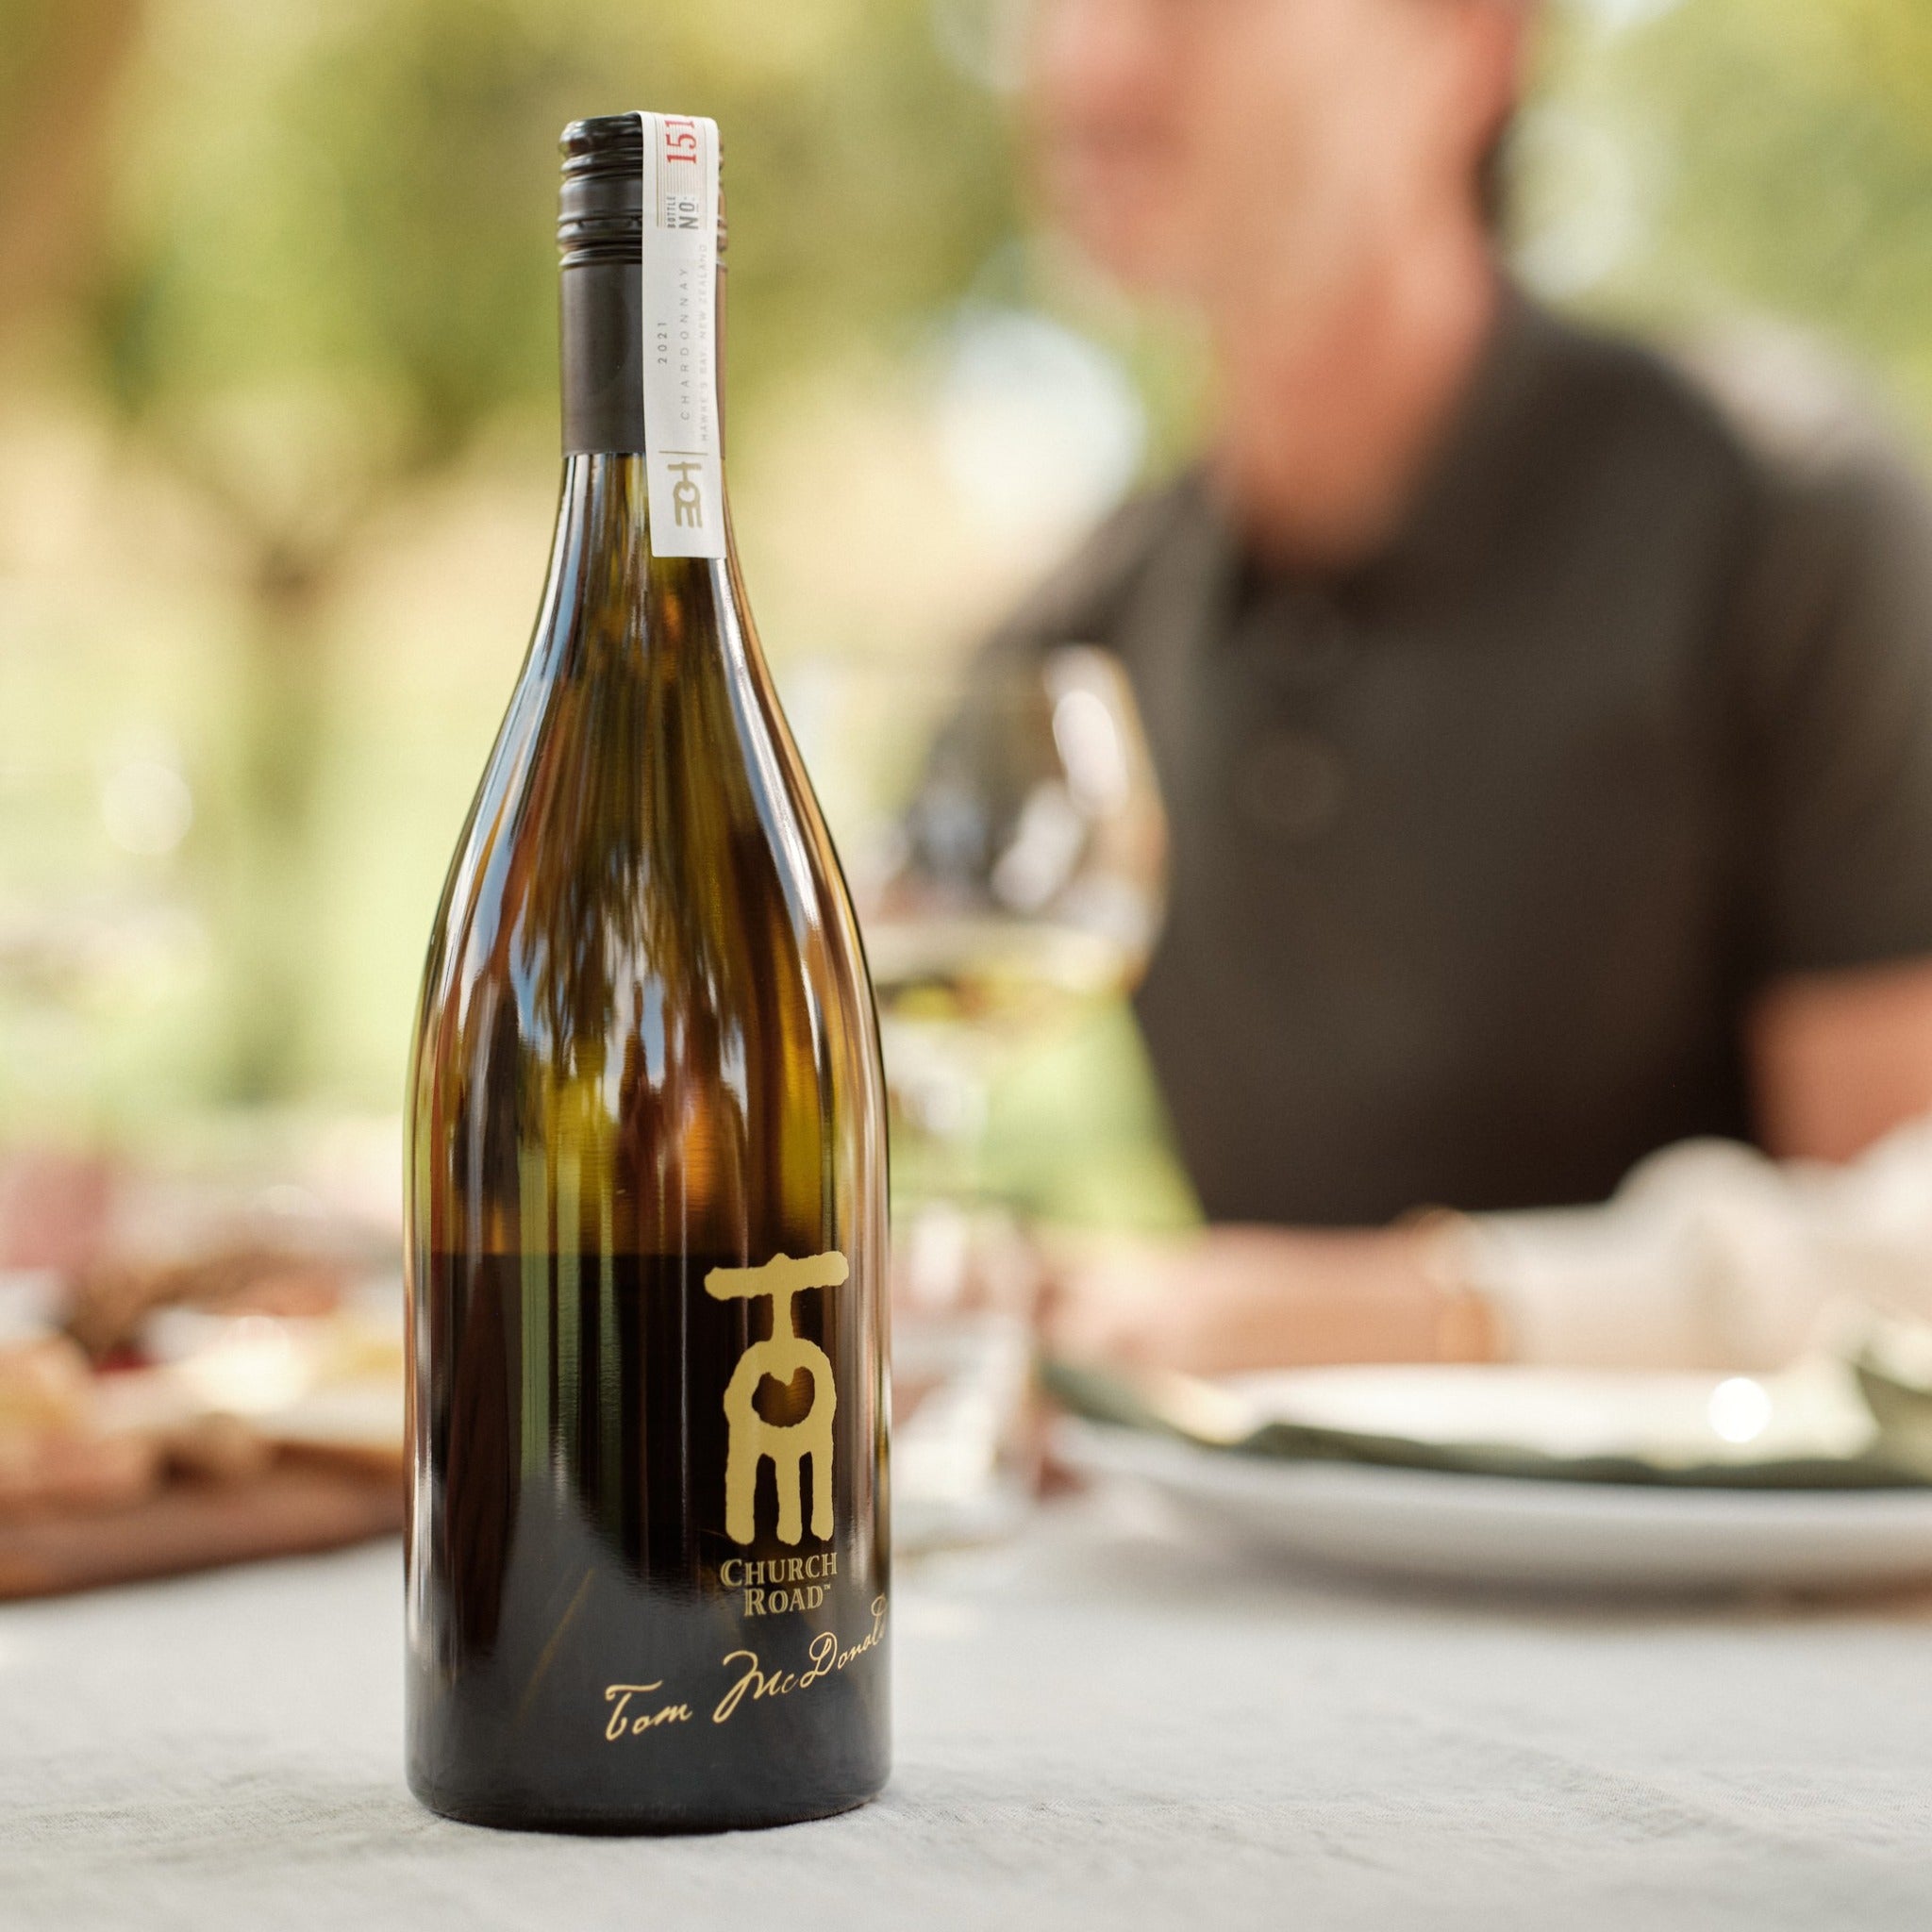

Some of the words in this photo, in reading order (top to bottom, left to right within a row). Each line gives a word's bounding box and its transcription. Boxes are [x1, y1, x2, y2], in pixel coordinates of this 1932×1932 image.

[664, 120, 697, 164] 151
[666, 196, 676, 228] BOTTLE
[698, 243, 708, 304] ZEALAND
[657, 321, 668, 365] 2021
[679, 267, 691, 422] CHARDONNAY
[698, 310, 708, 338] NEW
[720, 1552, 838, 1587] CHURCH
[605, 1680, 692, 1741] Tom
